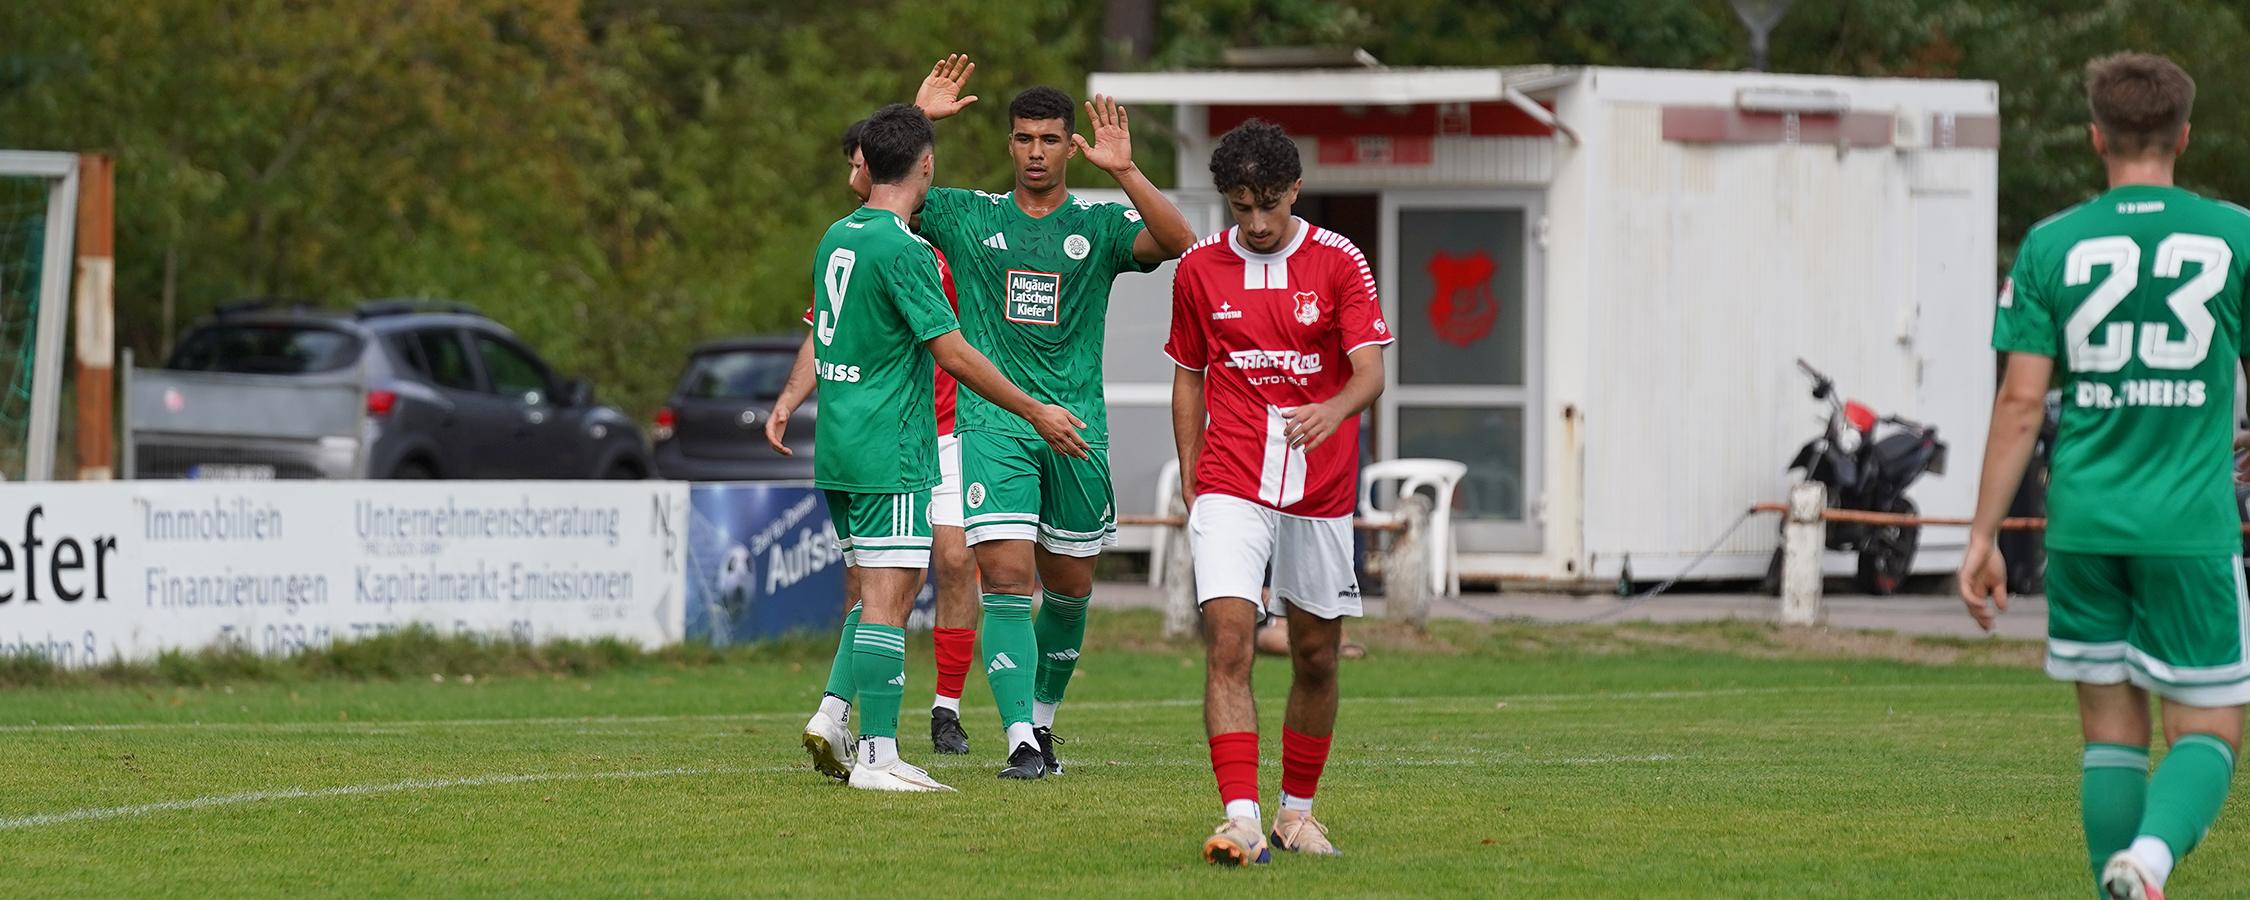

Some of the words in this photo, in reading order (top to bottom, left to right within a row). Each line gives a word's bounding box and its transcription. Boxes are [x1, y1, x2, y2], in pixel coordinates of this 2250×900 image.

[817, 247, 856, 347] 9
[1010, 289, 1054, 304] Latschen
[1011, 277, 1055, 292] Allgäuer
[2064, 232, 2233, 373] 23
[1247, 375, 1308, 387] AUTOTE
[144, 496, 283, 541] Immobilien
[354, 496, 621, 547] Unternehmensberatung
[145, 566, 328, 614] Finanzierungen
[354, 560, 634, 612] Kapitalmarkt-Emissionen
